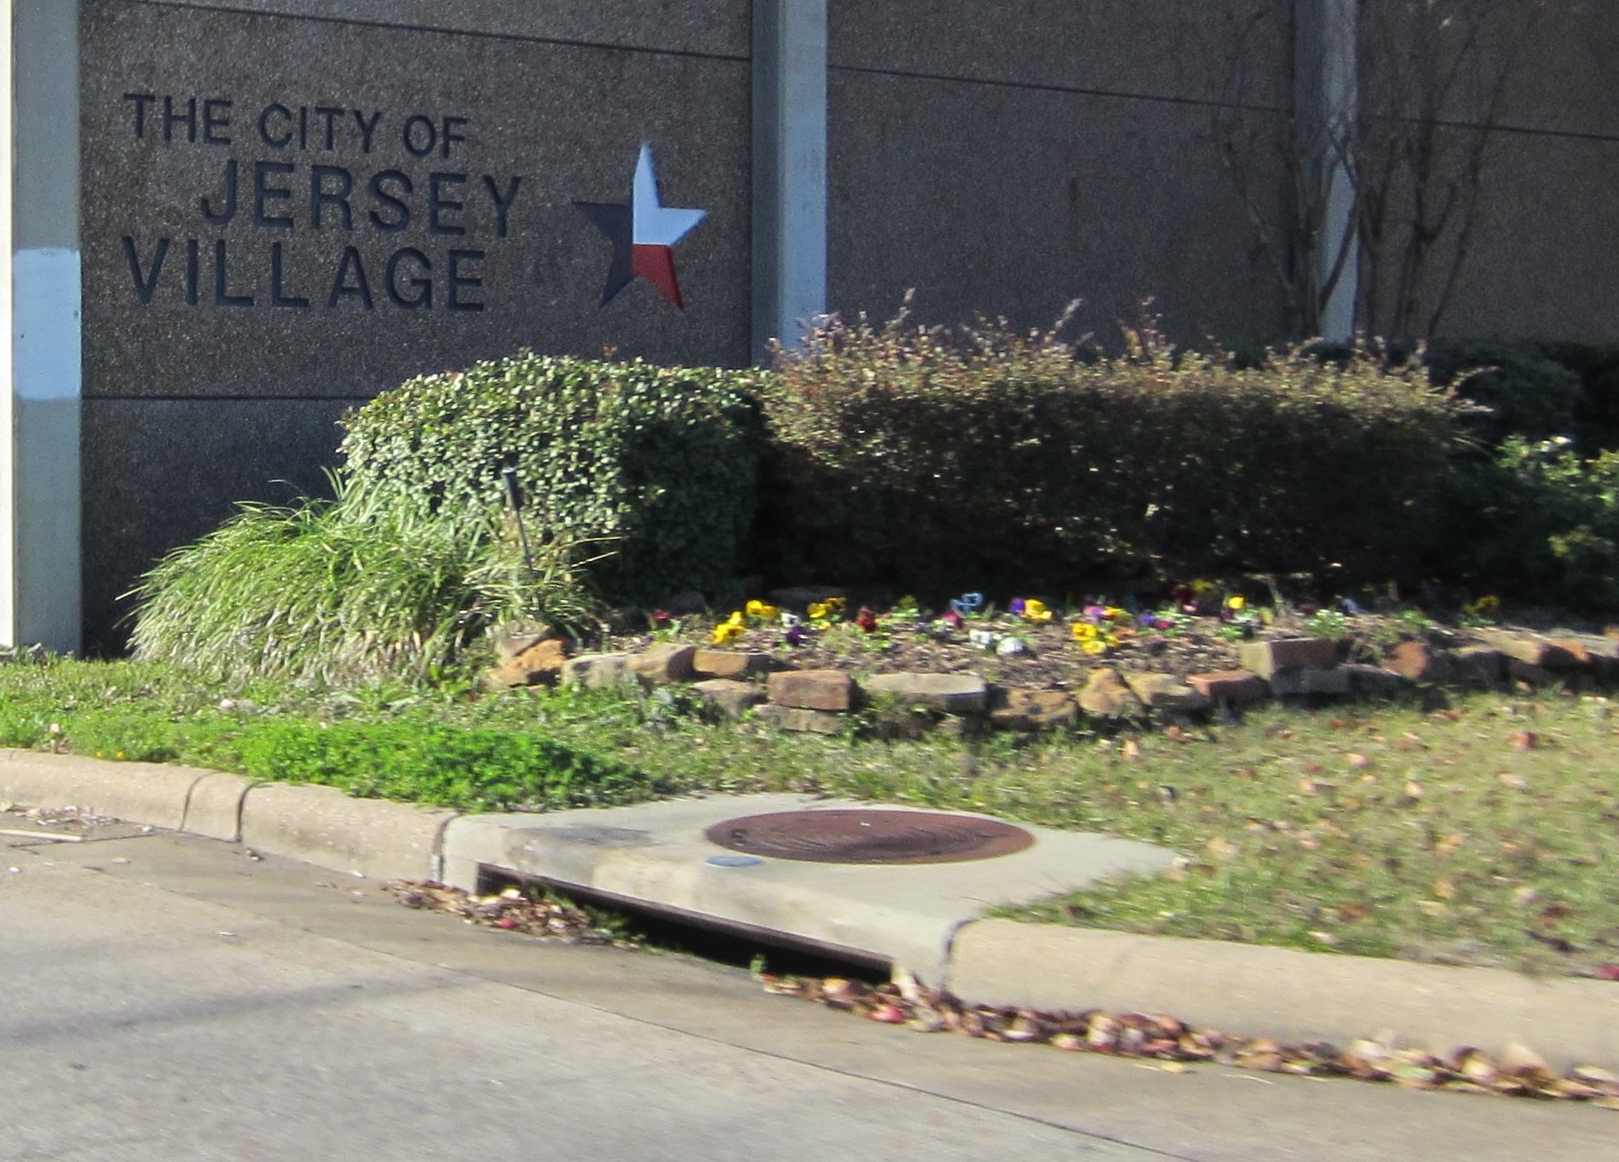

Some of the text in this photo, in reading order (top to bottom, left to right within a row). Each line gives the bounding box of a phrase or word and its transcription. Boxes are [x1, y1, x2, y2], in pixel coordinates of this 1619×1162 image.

[123, 93, 468, 159] THE CITY OF
[199, 159, 522, 238] JERSEY
[122, 236, 485, 312] VILLAGE
